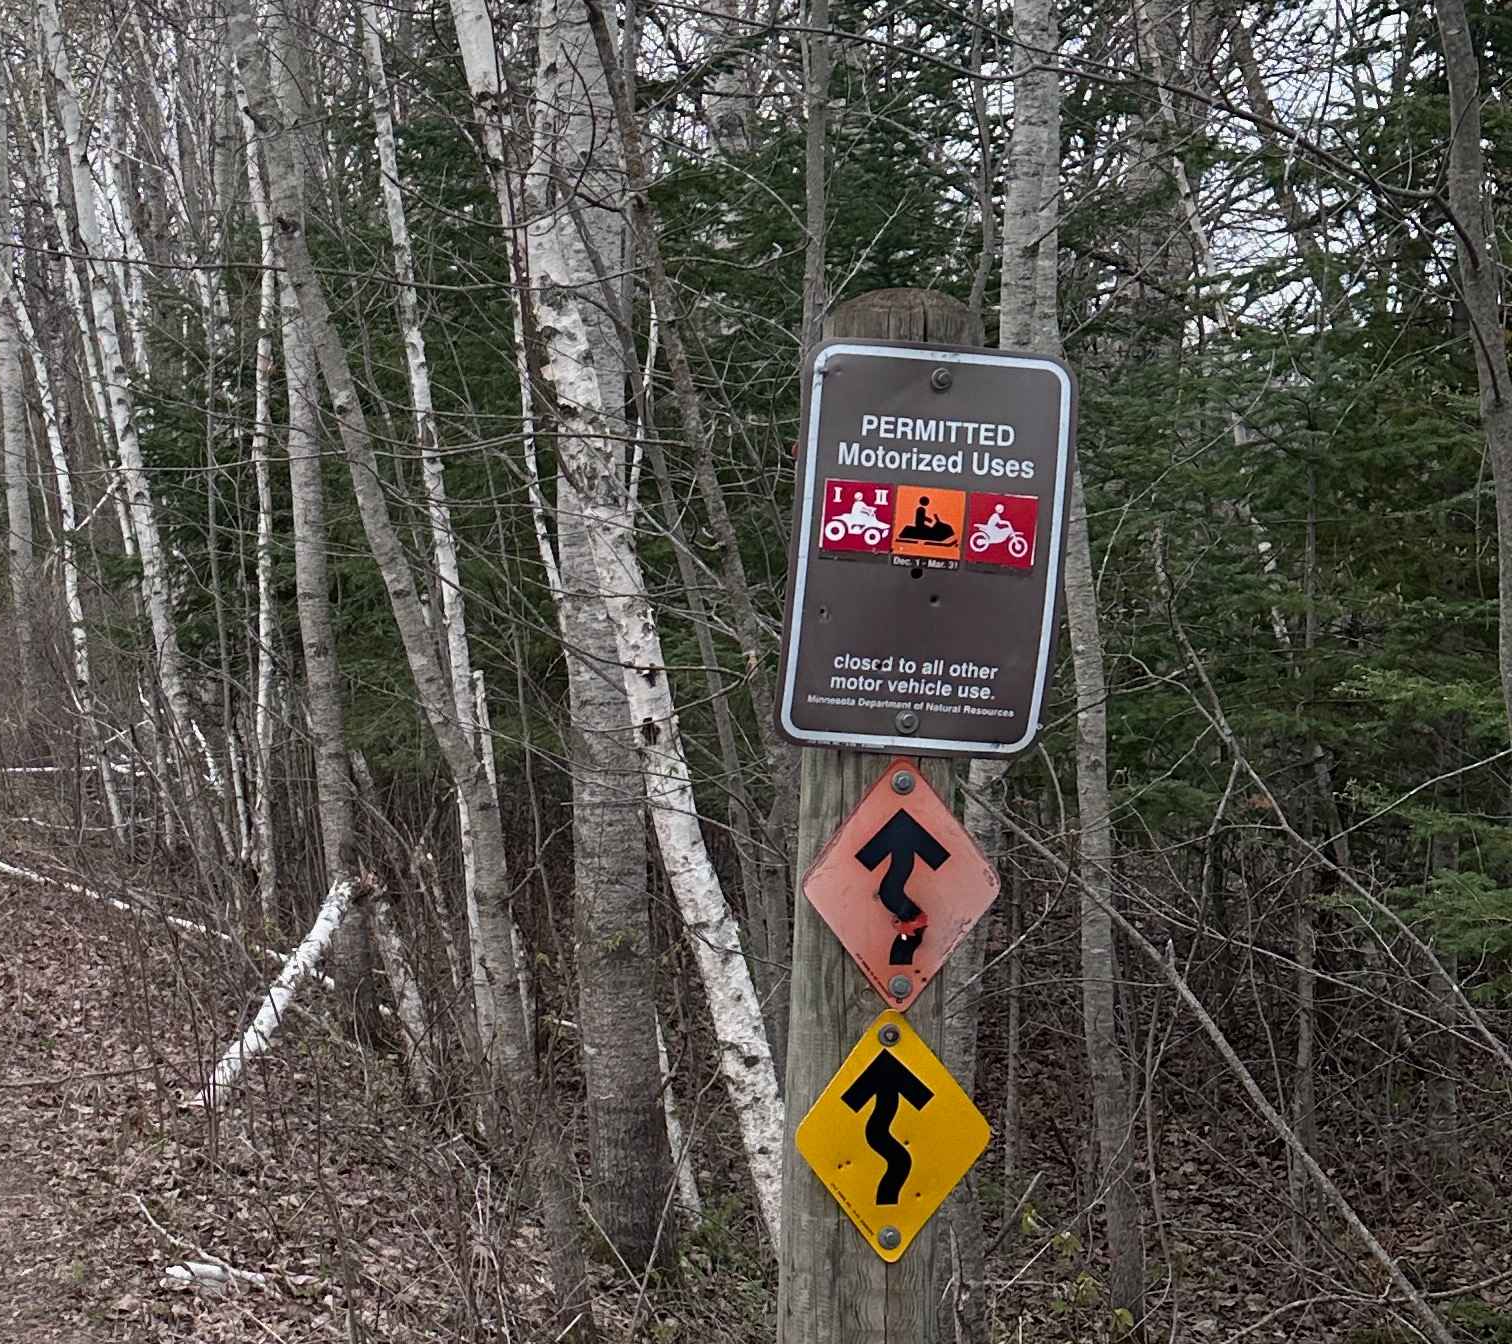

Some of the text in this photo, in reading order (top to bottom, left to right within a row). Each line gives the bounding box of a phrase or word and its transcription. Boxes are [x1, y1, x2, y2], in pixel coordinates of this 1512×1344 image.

[861, 414, 1015, 447] PERMITTED
[838, 441, 1035, 479] Motorized Uses
[833, 487, 889, 505] I II
[927, 559, 947, 569] Mar.
[834, 653, 999, 680] closed to all other
[830, 675, 996, 700] motor vehicle use.
[807, 694, 1015, 718] Minnesota Department of Natural Resources
